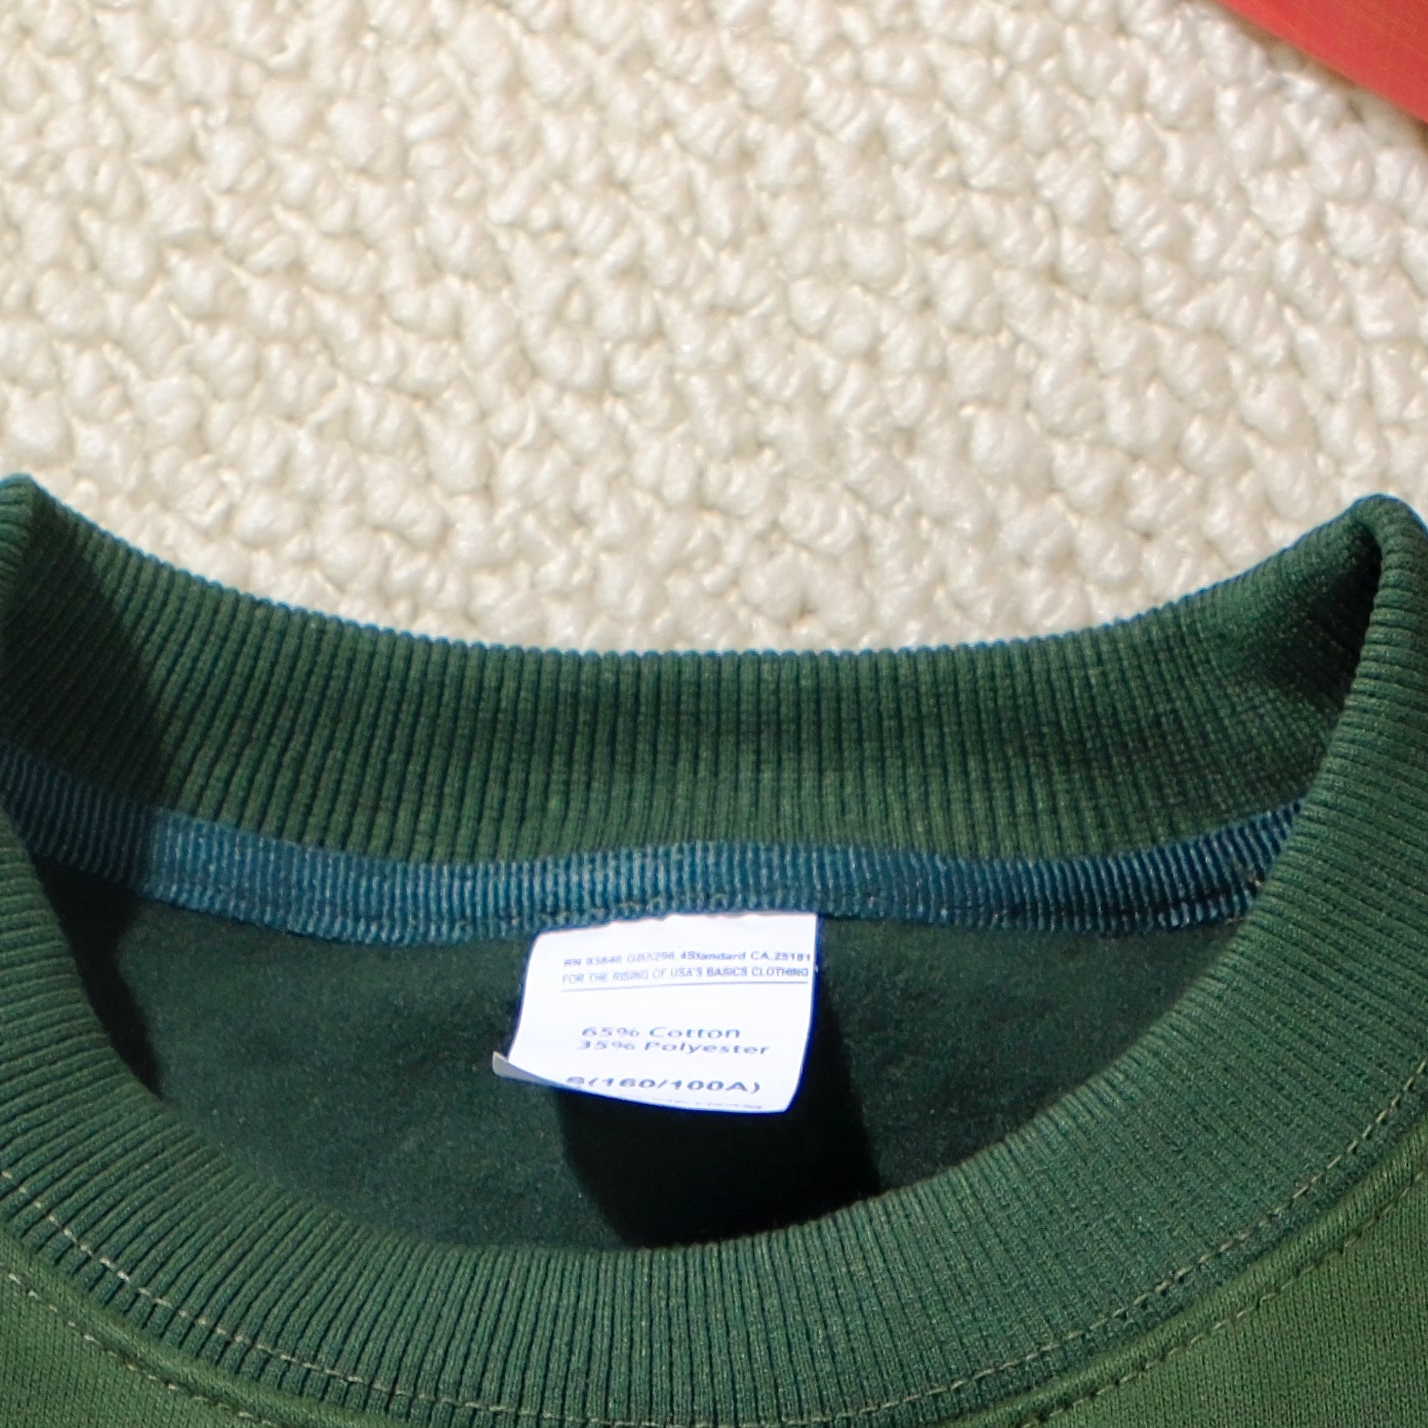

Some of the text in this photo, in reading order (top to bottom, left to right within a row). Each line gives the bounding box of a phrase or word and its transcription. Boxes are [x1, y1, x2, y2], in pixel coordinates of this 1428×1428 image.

[581, 1026, 741, 1040] 65% Cotton
[577, 1040, 770, 1056] 35% Polyester
